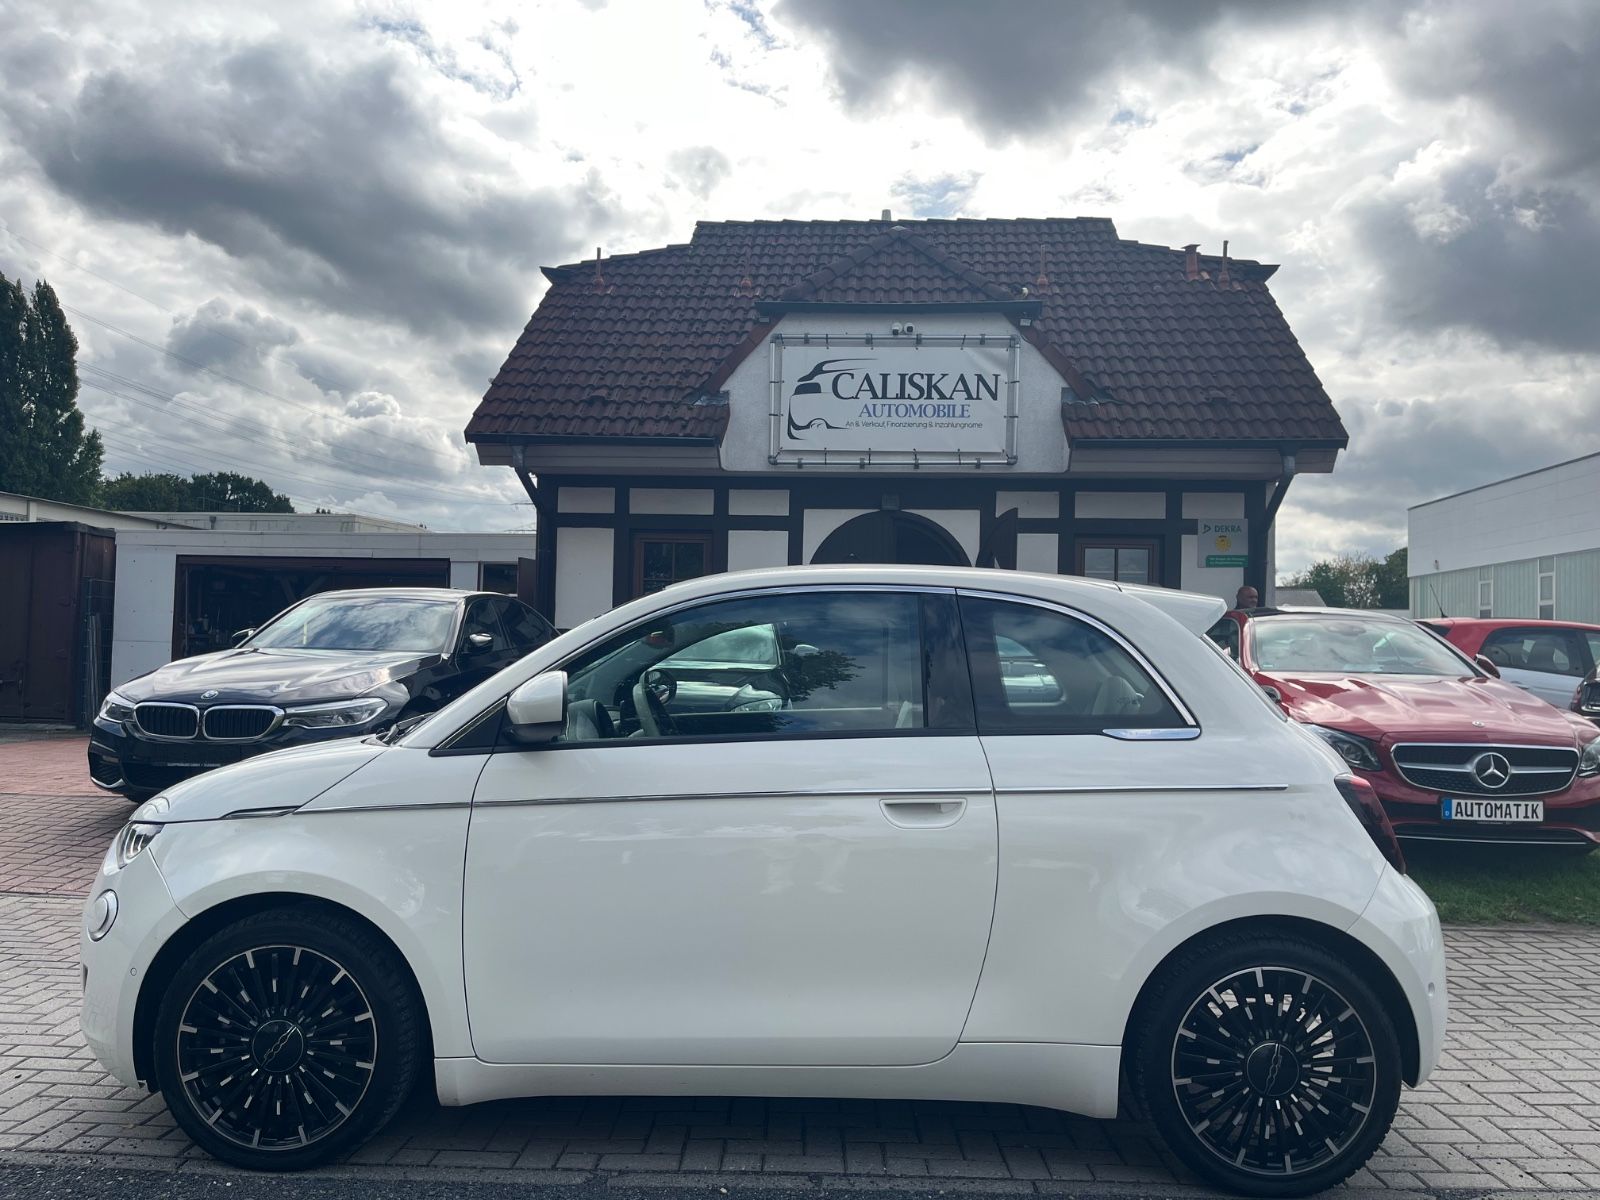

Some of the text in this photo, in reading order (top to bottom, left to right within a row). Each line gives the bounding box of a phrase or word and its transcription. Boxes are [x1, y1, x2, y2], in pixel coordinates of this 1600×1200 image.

[832, 372, 1001, 401] CALISKAN
[859, 403, 971, 419] AUTOMOBILE
[887, 421, 927, 429] Finanzierung
[1214, 524, 1242, 533] DEKRA
[1454, 802, 1540, 819] AUTOMATIK
